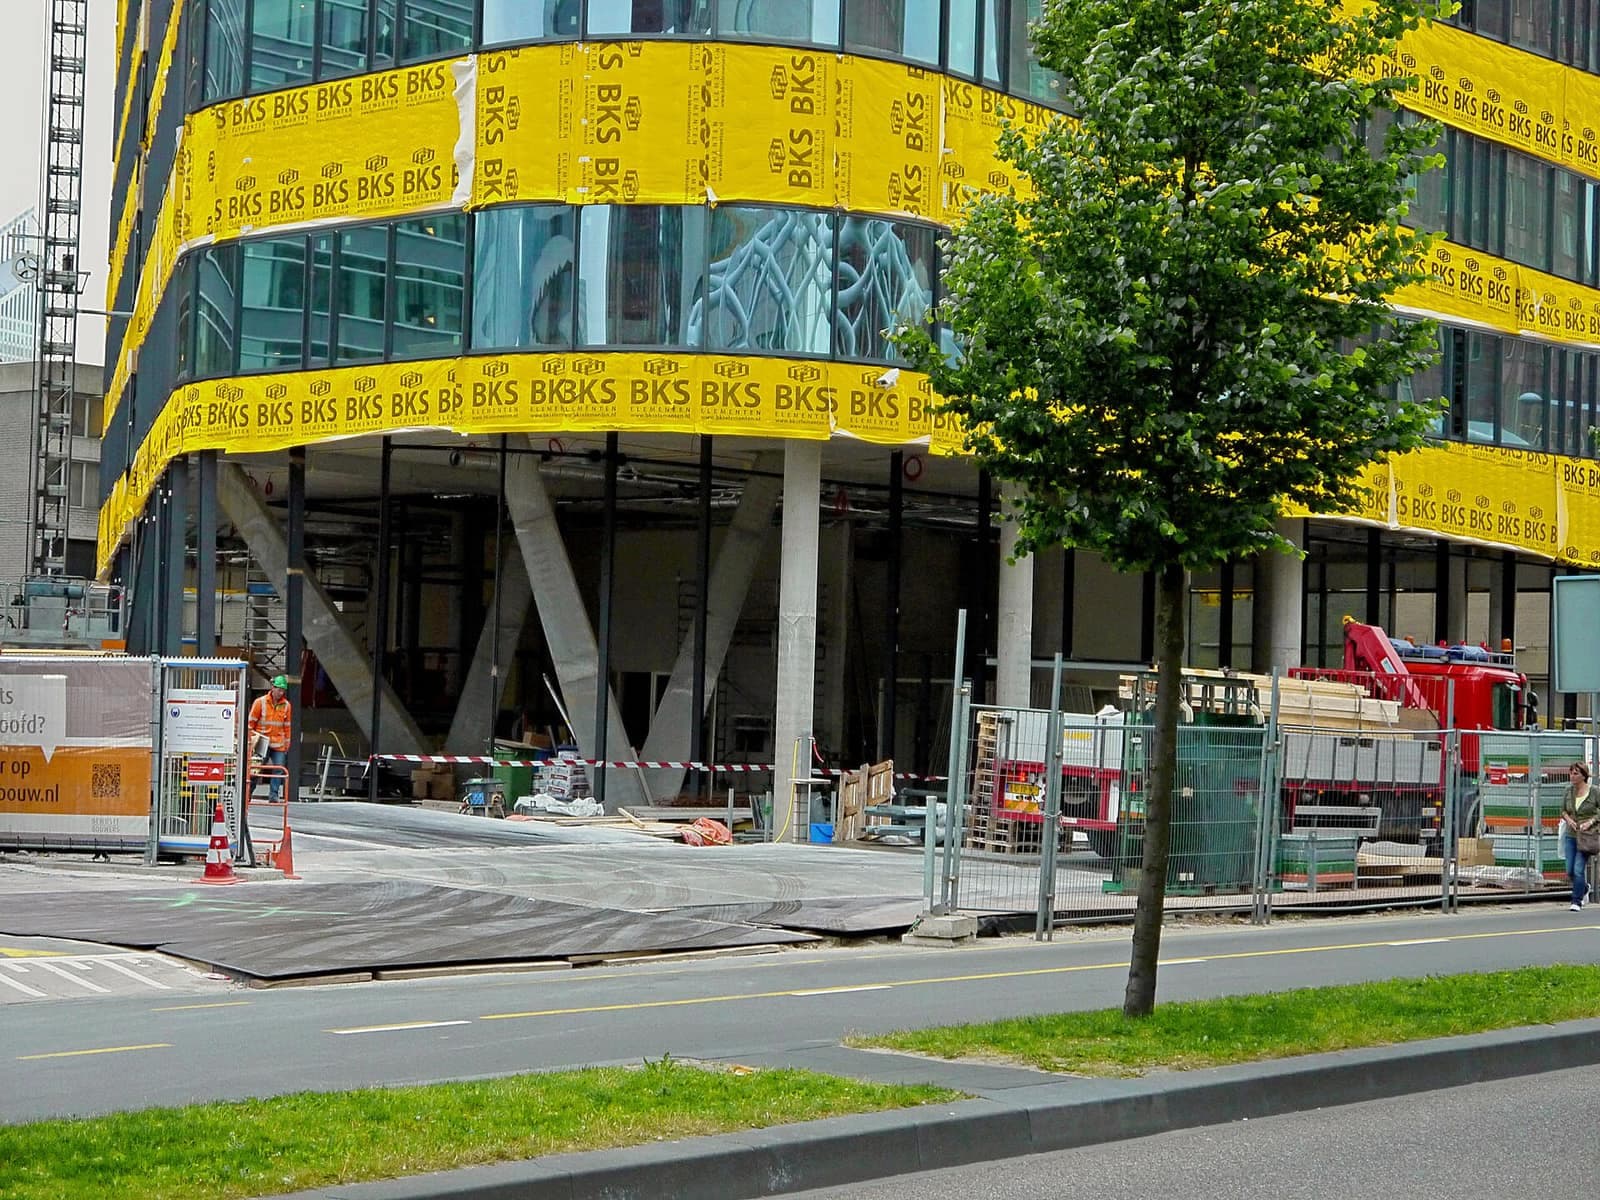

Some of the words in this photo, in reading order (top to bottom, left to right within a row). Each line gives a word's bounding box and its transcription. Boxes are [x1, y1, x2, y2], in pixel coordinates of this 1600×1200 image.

[232, 98, 266, 126] BKS
[273, 90, 309, 118] BKS
[317, 82, 352, 111] BKS
[361, 74, 398, 102] BKS
[406, 65, 446, 94] BKS
[596, 84, 622, 144] BKS
[791, 56, 816, 114] BKS
[486, 86, 504, 146] BKS
[906, 92, 924, 152] BKS
[1024, 102, 1050, 128] BK
[1425, 80, 1449, 104] BKS
[1454, 91, 1478, 116] BKS
[1482, 102, 1504, 127] BKS
[1509, 113, 1532, 138] BKS
[1536, 124, 1557, 148] BKS
[1578, 140, 1598, 164] BKS
[594, 158, 620, 203] BK
[788, 128, 814, 188] BKS
[229, 192, 262, 219] BKS
[270, 186, 304, 214] BKS
[312, 179, 348, 208] BKS
[358, 172, 394, 200] BKS
[403, 166, 441, 194] BKS
[1432, 262, 1455, 287] BKS
[1460, 272, 1483, 296] BKS
[1488, 280, 1510, 304] BKS
[1540, 306, 1560, 328] BKS
[1565, 312, 1586, 332] BKS
[182, 404, 202, 428] BKS
[258, 402, 294, 427] BKS
[302, 398, 337, 424] BKS
[346, 394, 382, 420] BKS
[392, 390, 430, 417] BKS
[472, 380, 518, 407] BKS
[630, 379, 690, 405] BKS
[701, 380, 760, 408] BKS
[775, 384, 838, 413] BKS
[850, 390, 900, 419] BKS
[1564, 464, 1585, 485] BKS
[1412, 498, 1436, 520] BKS
[1442, 504, 1466, 526] BKS
[1470, 510, 1492, 532] BKS
[1498, 514, 1520, 536] BKS
[1524, 520, 1546, 542] BKS
[12, 761, 30, 779] op
